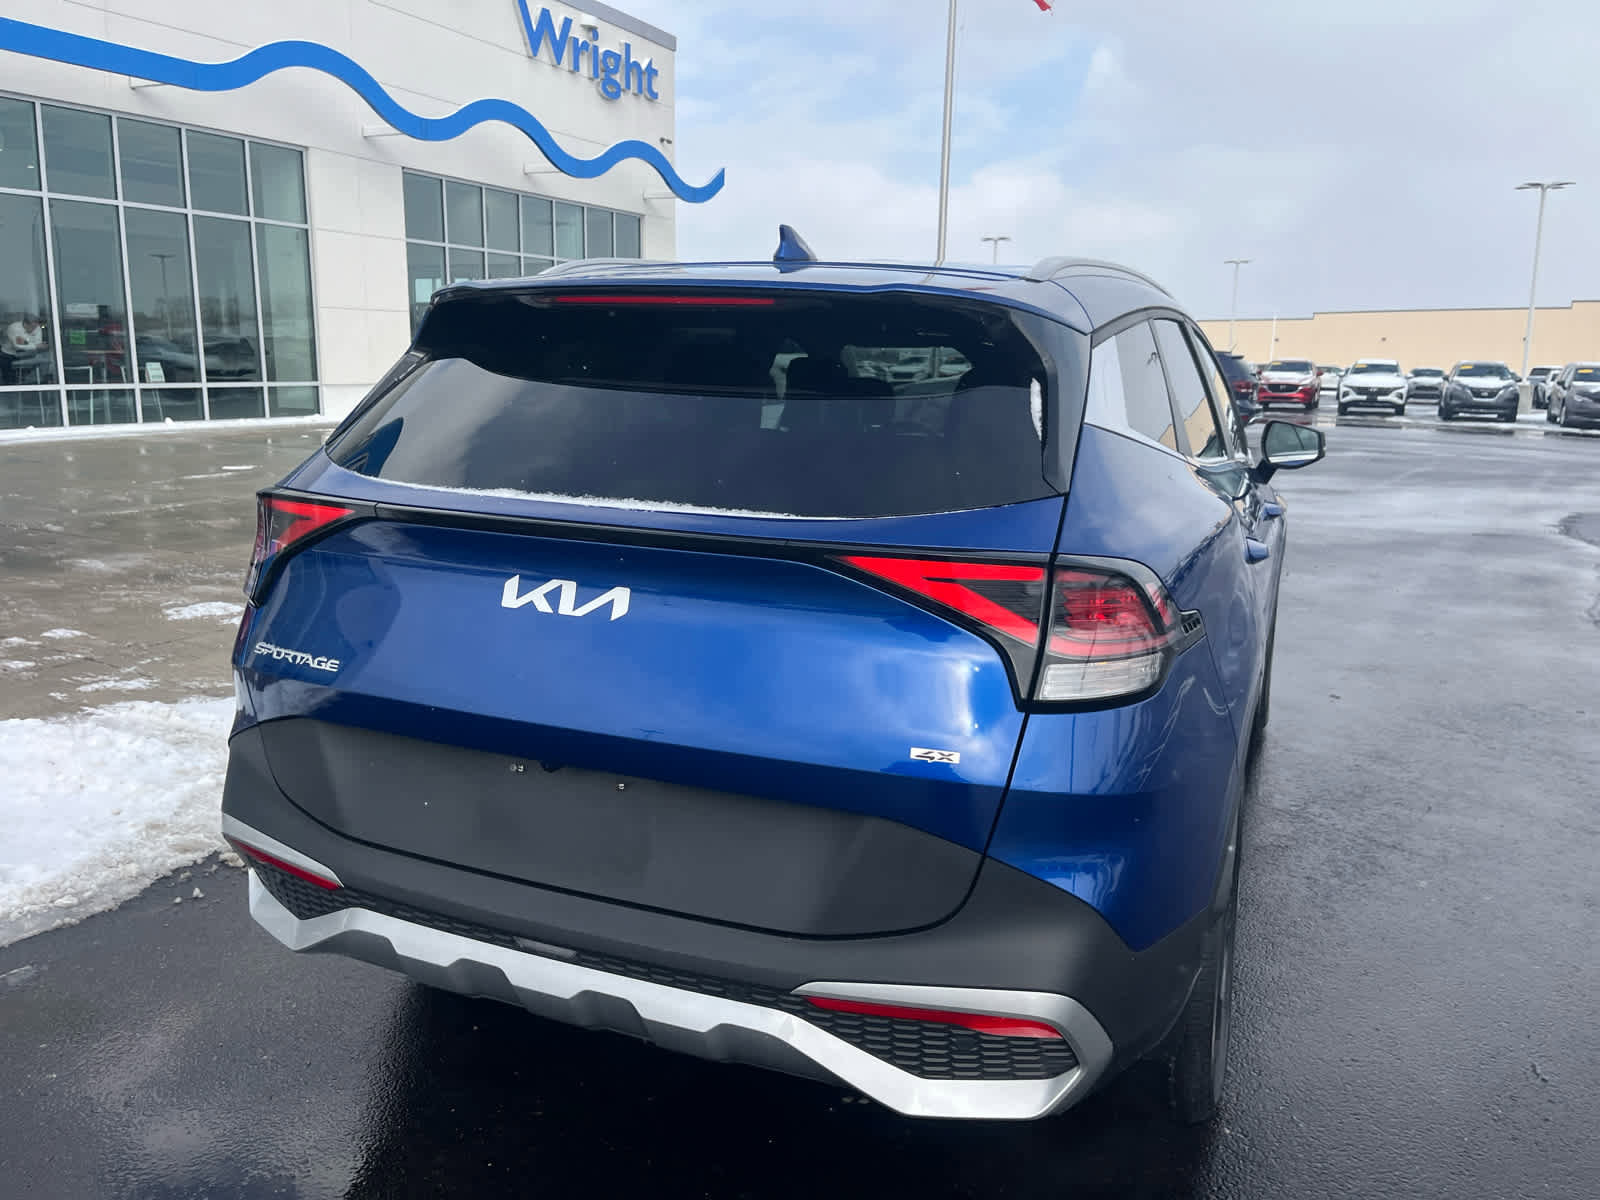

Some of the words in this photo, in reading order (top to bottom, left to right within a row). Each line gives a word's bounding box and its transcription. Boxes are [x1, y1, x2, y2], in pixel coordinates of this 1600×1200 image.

[517, 0, 659, 100] Wright
[501, 574, 631, 621] KIA
[254, 641, 340, 672] SPORTAGE
